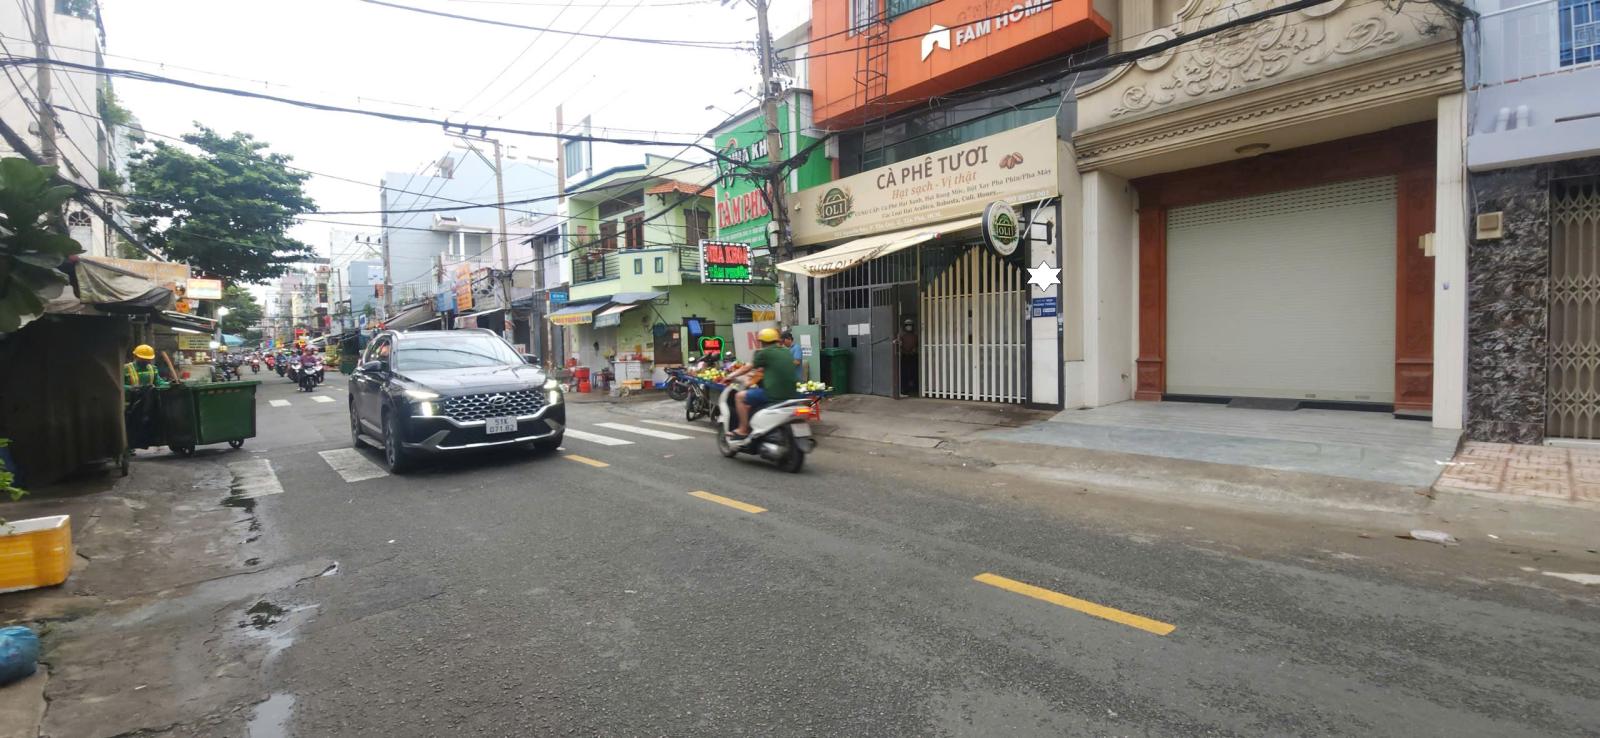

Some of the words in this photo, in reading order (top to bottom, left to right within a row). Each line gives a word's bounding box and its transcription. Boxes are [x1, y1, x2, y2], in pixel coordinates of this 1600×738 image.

[956, 19, 991, 46] FAM
[996, 0, 1052, 30] HOME
[876, 168, 897, 190] CÀ
[901, 156, 933, 184] PHÊ
[938, 145, 988, 174] TƯƠI
[911, 181, 933, 196] sạch
[954, 170, 976, 185] thật
[825, 203, 843, 216] OLI
[999, 227, 1011, 236] OLI
